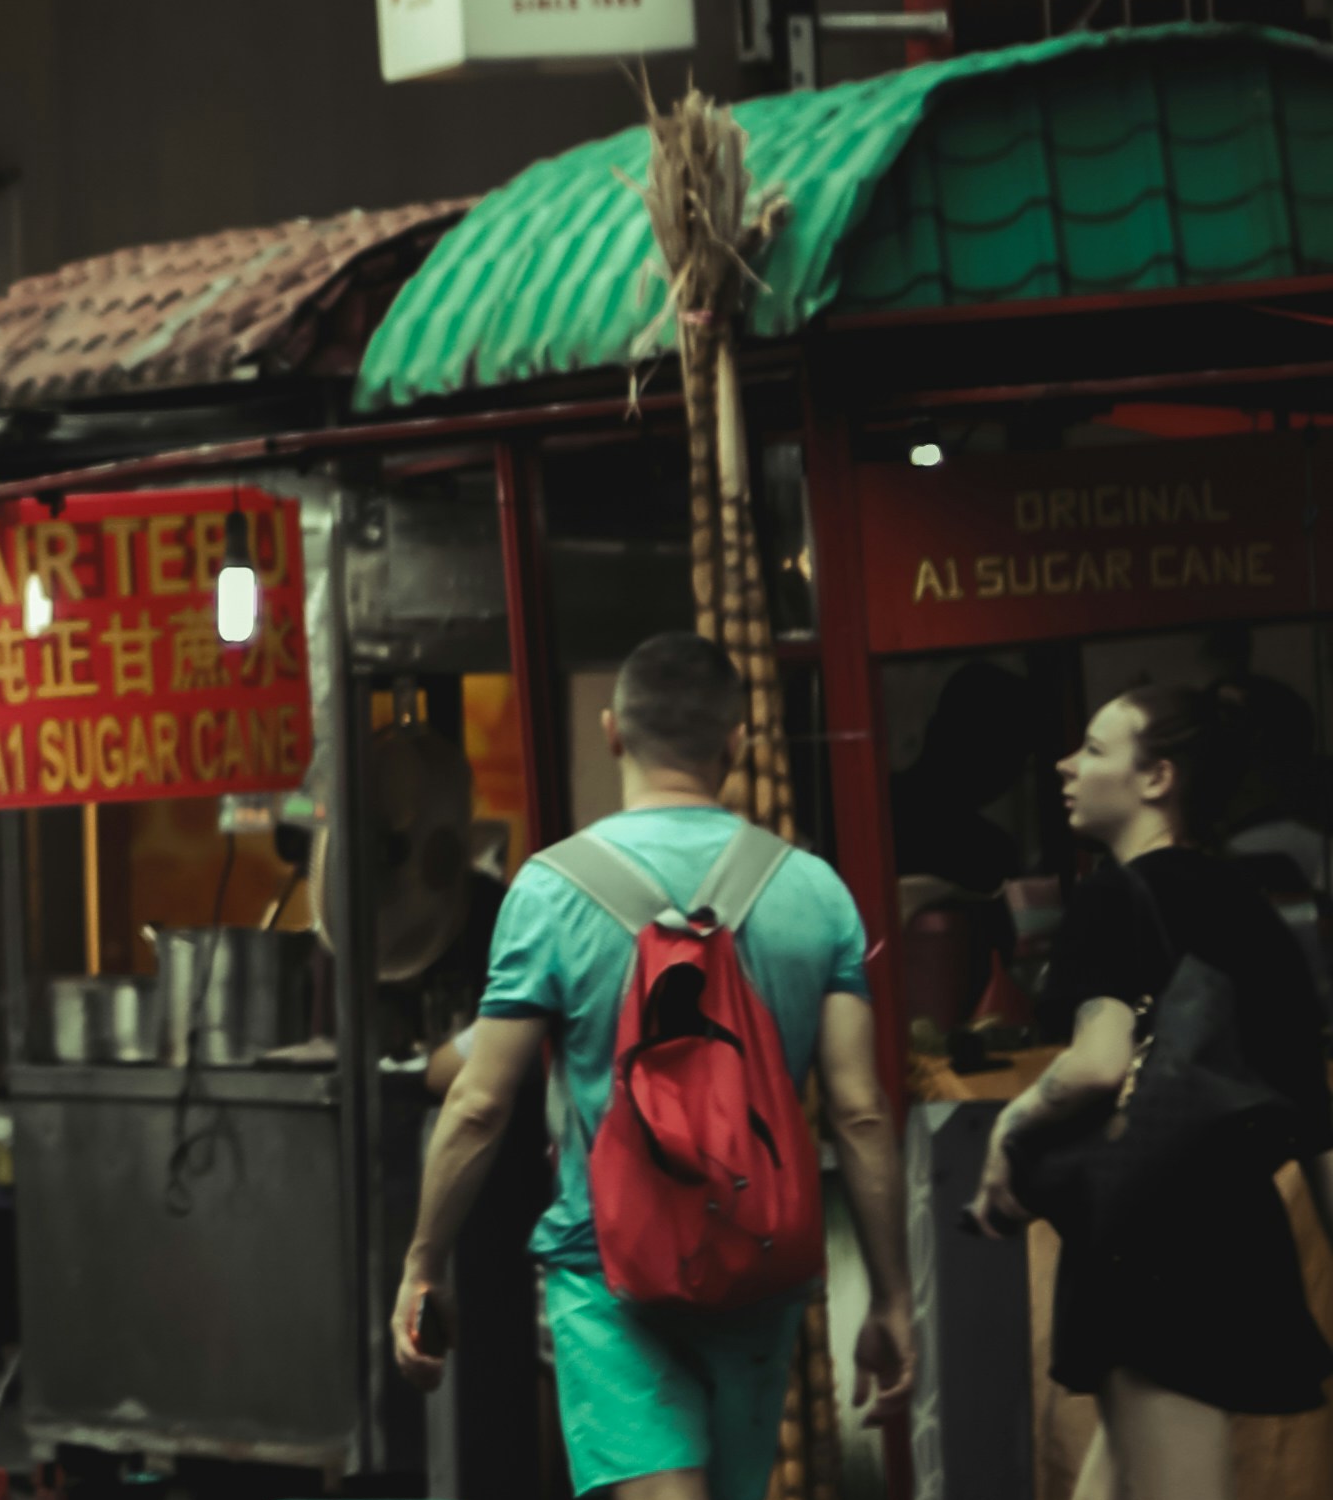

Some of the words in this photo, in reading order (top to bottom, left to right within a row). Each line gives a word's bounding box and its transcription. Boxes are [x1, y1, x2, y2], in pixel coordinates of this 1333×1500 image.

[1014, 479, 1230, 535] ORIGINAL
[101, 510, 288, 598] TEBU
[974, 546, 1133, 600] SUGAR
[1149, 541, 1275, 591] CANE
[38, 712, 182, 794] SUGAR
[190, 705, 300, 782] CANE
